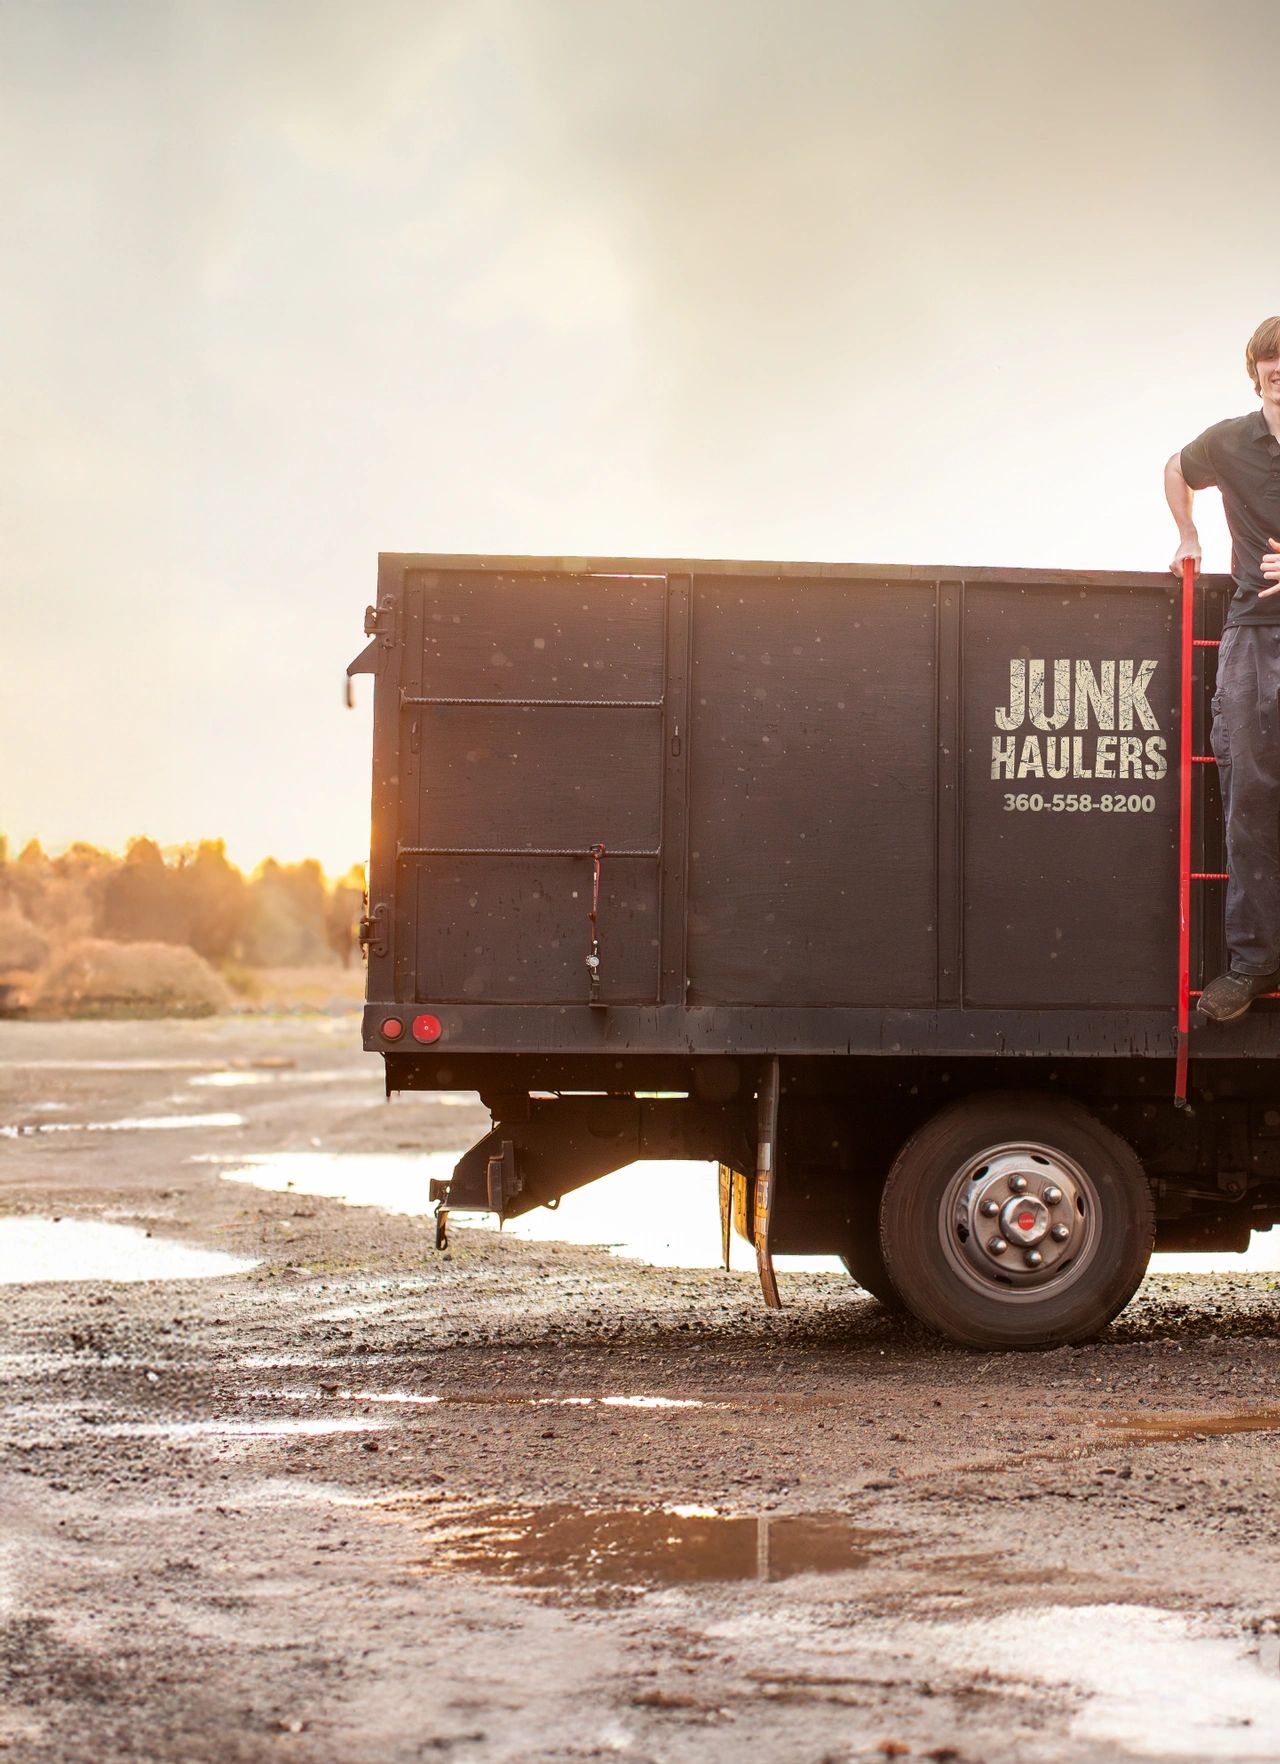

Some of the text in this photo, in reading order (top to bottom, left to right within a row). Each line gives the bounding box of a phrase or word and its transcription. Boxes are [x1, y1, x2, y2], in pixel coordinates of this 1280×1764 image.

[995, 658, 1160, 731] JUNK
[990, 735, 1168, 780] HAULERS
[1003, 793, 1156, 813] 360-558-8200
